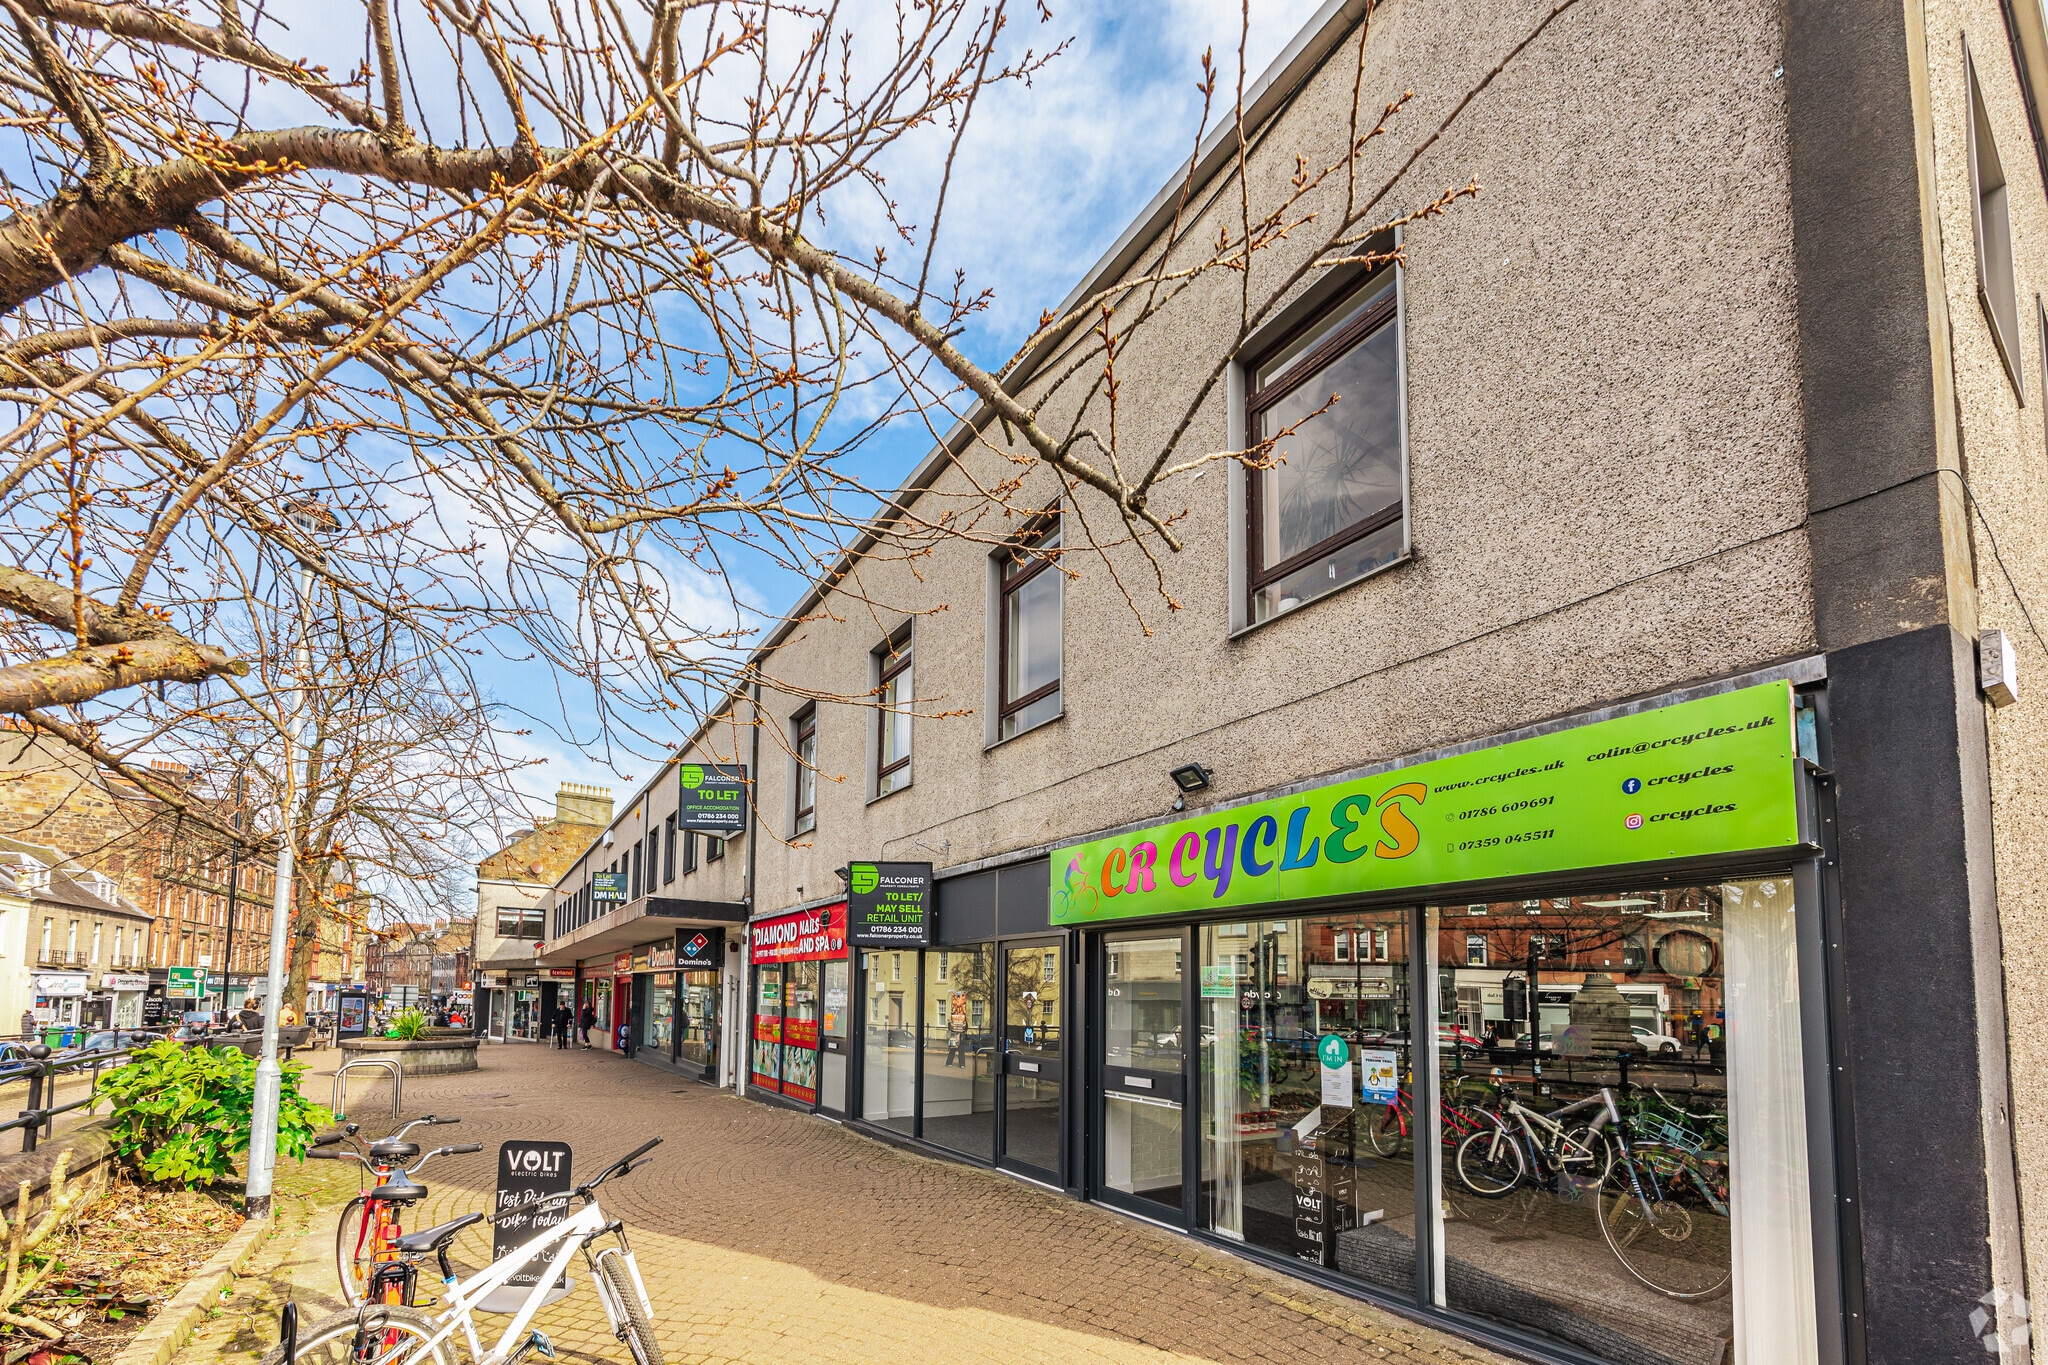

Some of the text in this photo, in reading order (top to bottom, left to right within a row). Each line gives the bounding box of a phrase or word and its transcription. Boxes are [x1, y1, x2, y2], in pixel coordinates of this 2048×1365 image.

[1586, 715, 1777, 762] colin@crcycles.uk
[1433, 759, 1566, 794] www.crcycles.uk
[1647, 764, 1735, 787] crcycles
[697, 789, 739, 800] TO LET
[1458, 795, 1555, 821] 01786 609691
[1649, 802, 1738, 823] crcycles
[1100, 781, 1428, 899] CR CYCLES
[1458, 828, 1555, 851] 07359 045511
[880, 876, 924, 885] FALCONER
[594, 891, 607, 899] DM
[886, 892, 924, 902] TO LET/
[876, 904, 923, 913] MAY SELL
[867, 913, 923, 923] RETAIL UNIT
[755, 917, 820, 946] DIAMOND NAILS
[870, 925, 892, 933] 01786
[799, 937, 814, 953] AND
[815, 935, 830, 952] SPA
[678, 958, 712, 966] Domino's
[1322, 1054, 1343, 1063] I'M IN
[507, 1149, 565, 1171] VOLT
[498, 1189, 522, 1208] Test
[1295, 1194, 1322, 1210] VOLT
